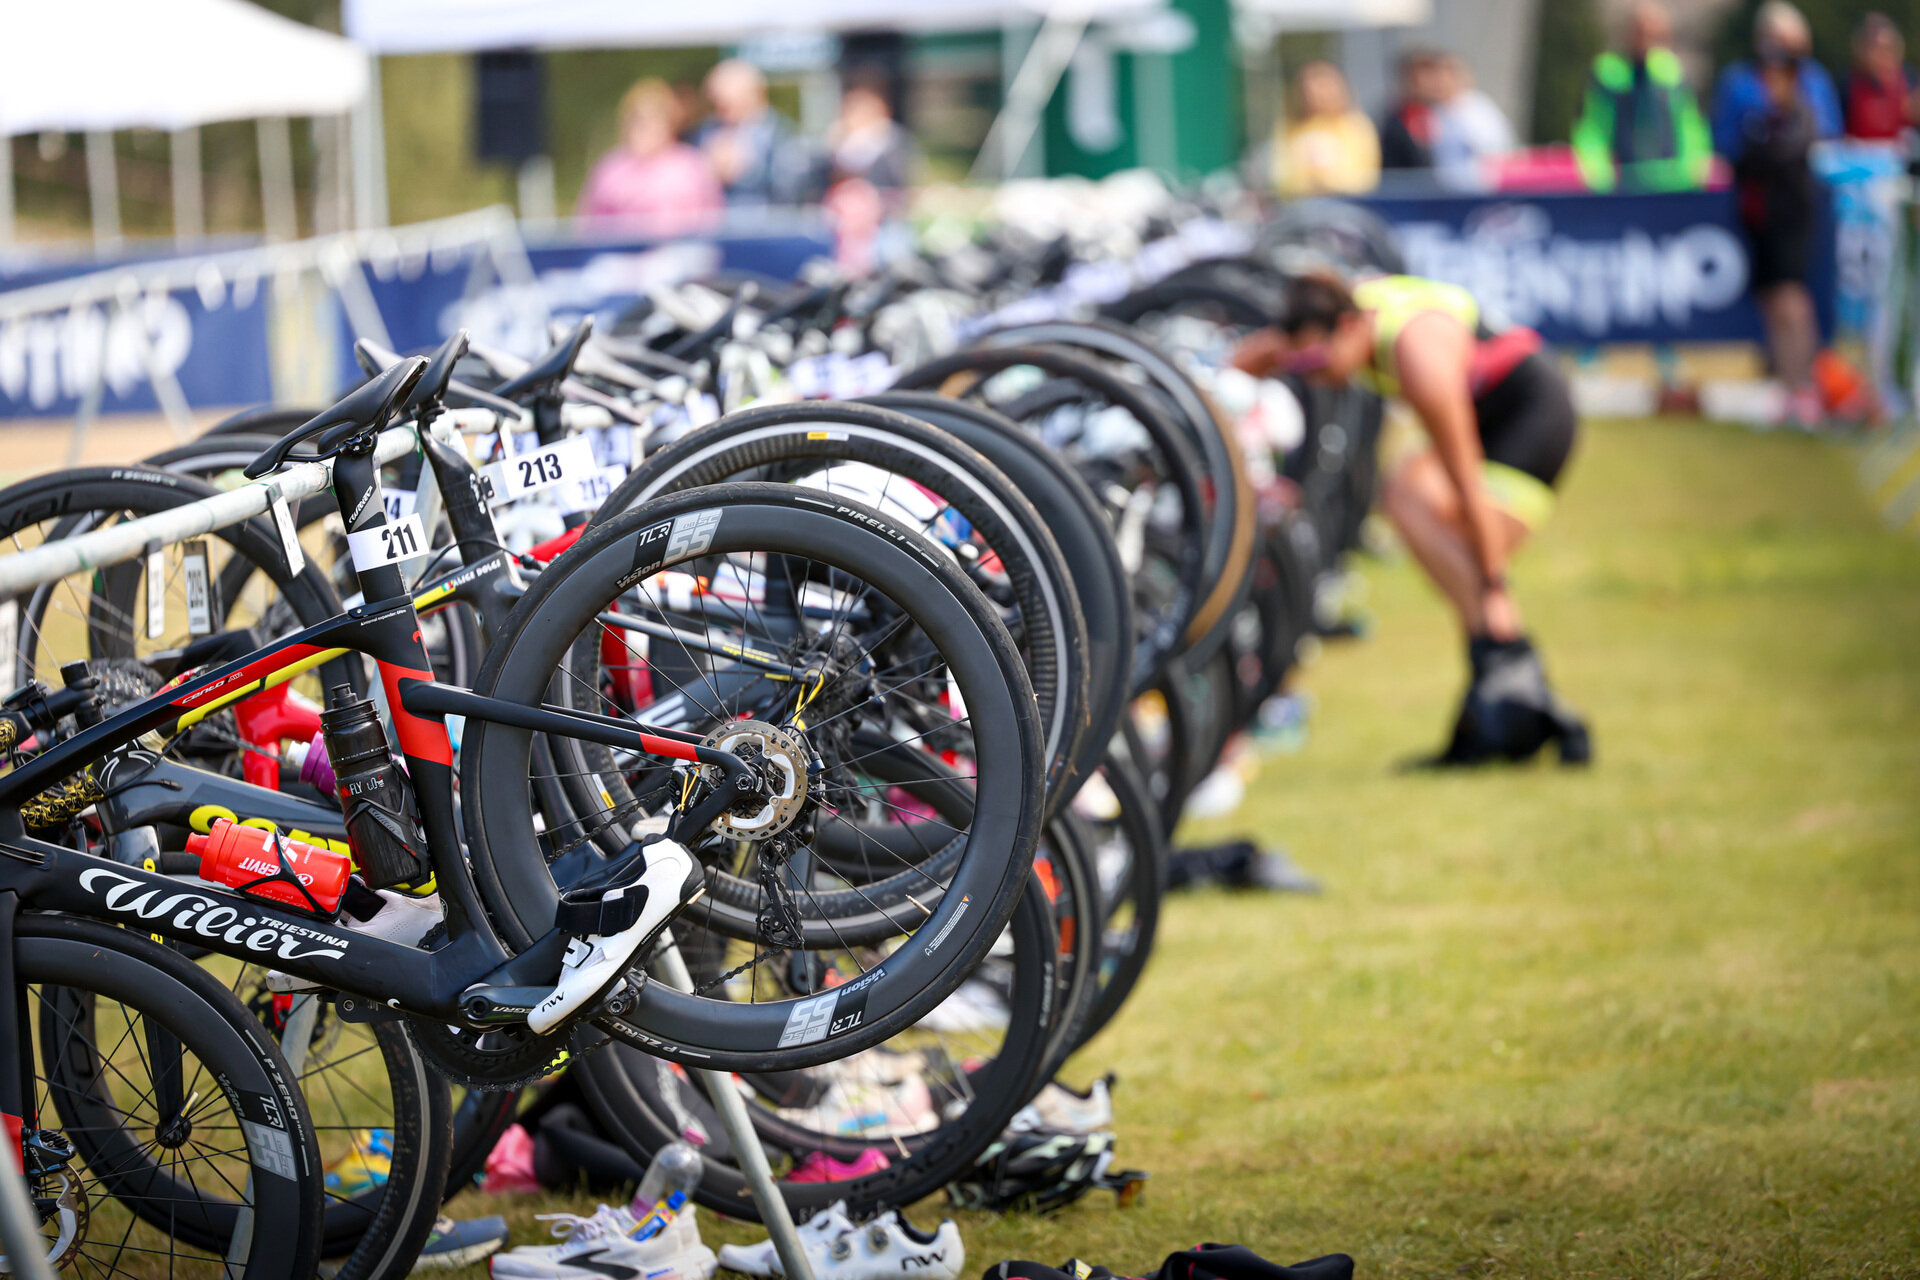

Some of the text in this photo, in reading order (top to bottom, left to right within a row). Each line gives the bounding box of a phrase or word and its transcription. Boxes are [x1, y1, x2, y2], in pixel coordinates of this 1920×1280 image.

[518, 453, 563, 488] 213
[639, 521, 672, 547] TLR
[837, 505, 906, 542] PIRELLI
[381, 522, 418, 560] 211
[664, 522, 715, 563] 55
[350, 782, 363, 796] FLY
[239, 857, 281, 876] ERVIT
[79, 868, 346, 960] Wilier
[260, 916, 349, 949] TRIESTINA
[493, 1006, 533, 1014] EGRA
[786, 996, 836, 1034] 55
[829, 1010, 863, 1035] TLR
[612, 1022, 676, 1056] P ZERO
[264, 1058, 276, 1069] P
[272, 1072, 299, 1120] ZERO
[260, 1096, 285, 1128] TLR
